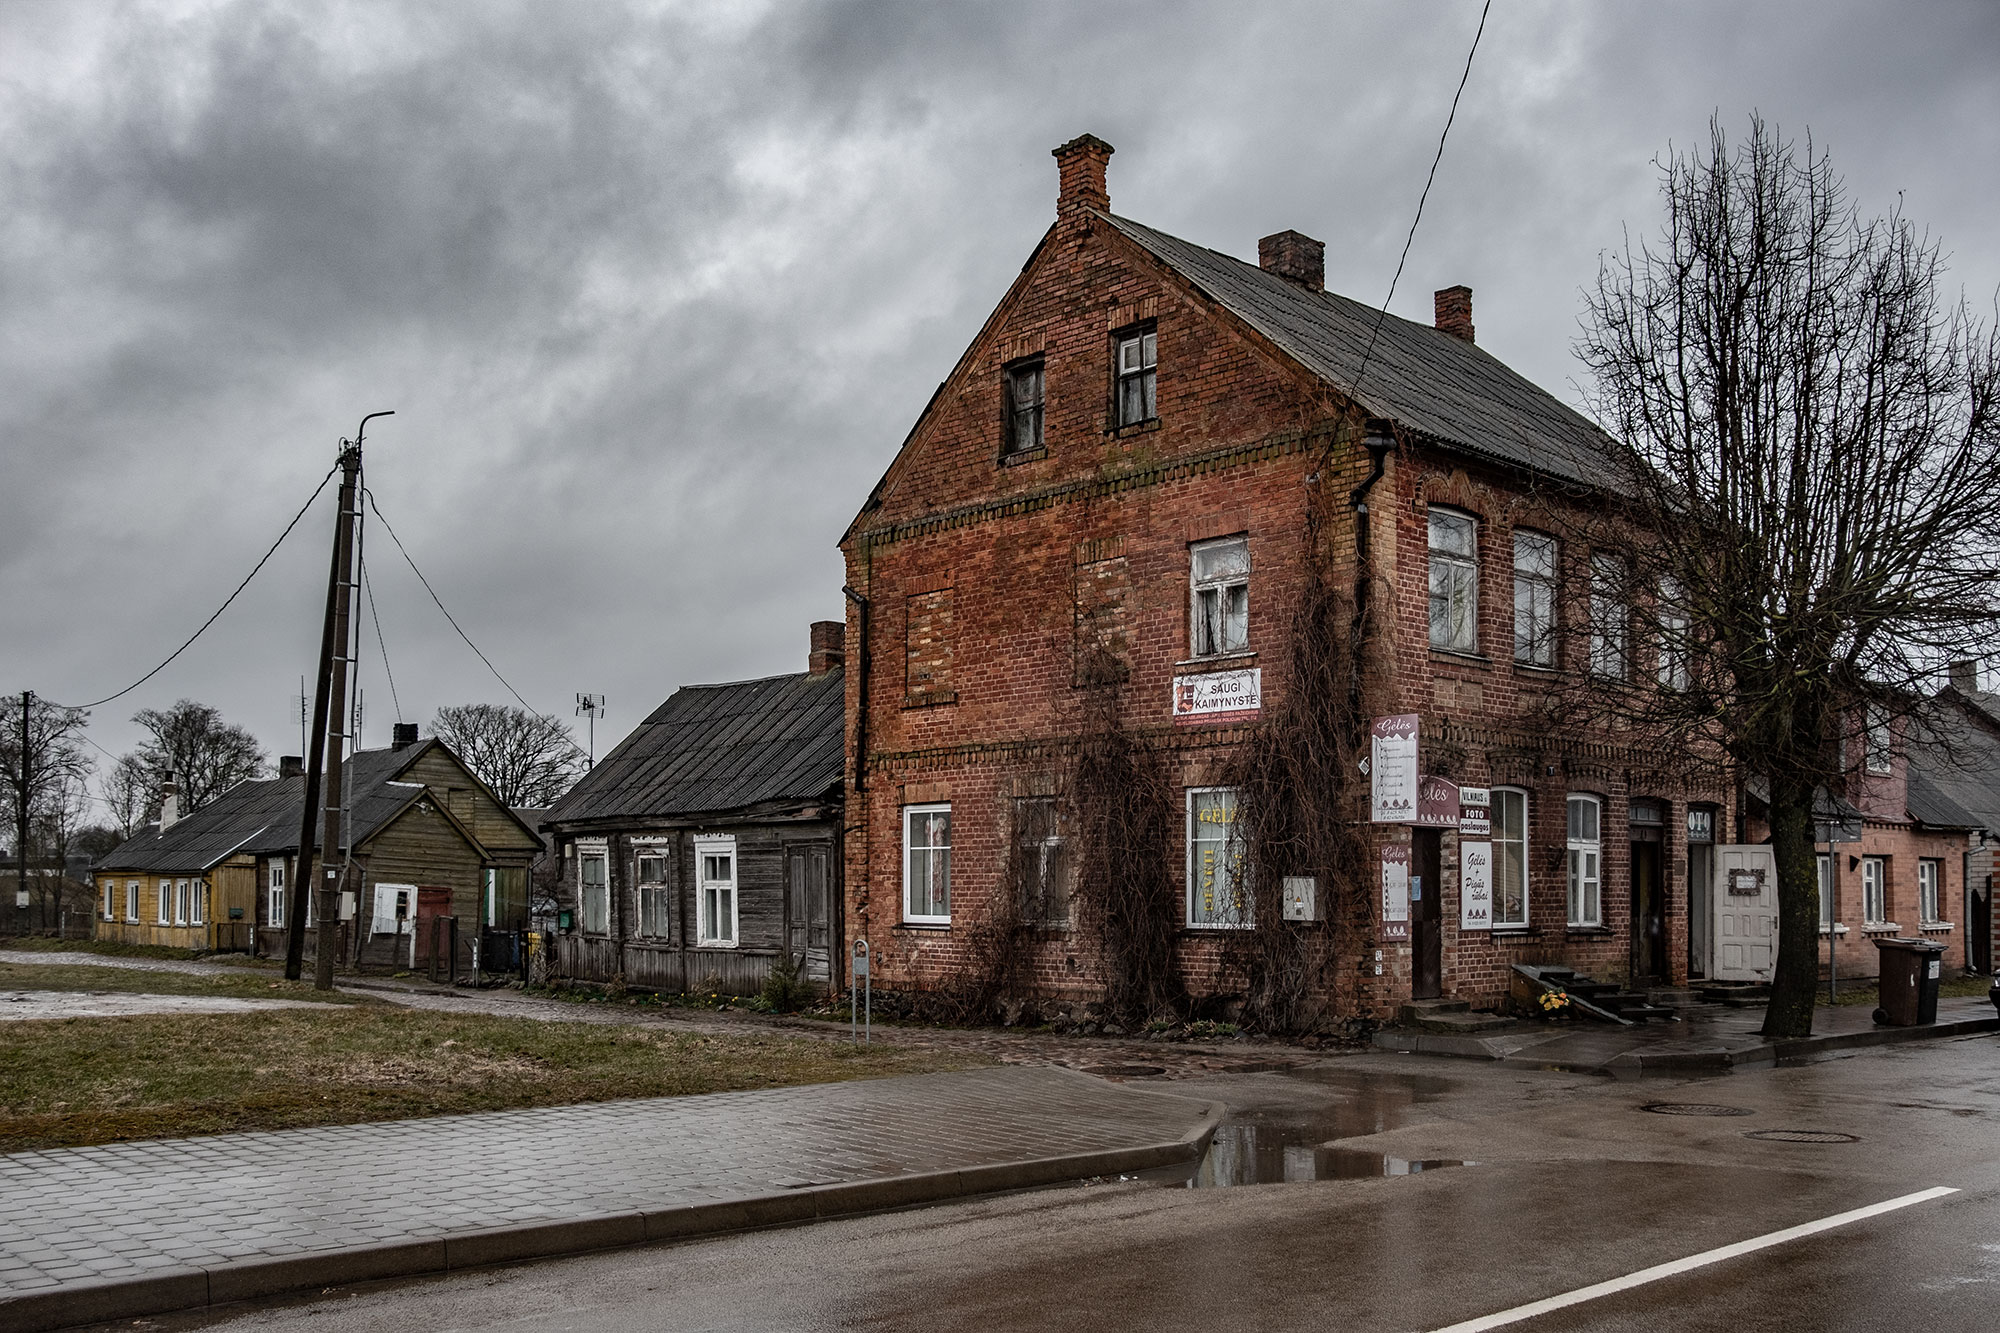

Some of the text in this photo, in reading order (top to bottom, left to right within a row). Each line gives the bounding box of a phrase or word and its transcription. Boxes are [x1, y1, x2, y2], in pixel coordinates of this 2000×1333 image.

[1210, 682, 1241, 694] SAUGI
[1195, 692, 1257, 709] KAIMYNYSTĖ
[1377, 718, 1412, 734] Gėlės
[1466, 809, 1484, 819] FOTO
[1461, 821, 1489, 832] paslaugos
[1382, 845, 1406, 862] Gėlės
[1467, 852, 1486, 870] Gėlės
